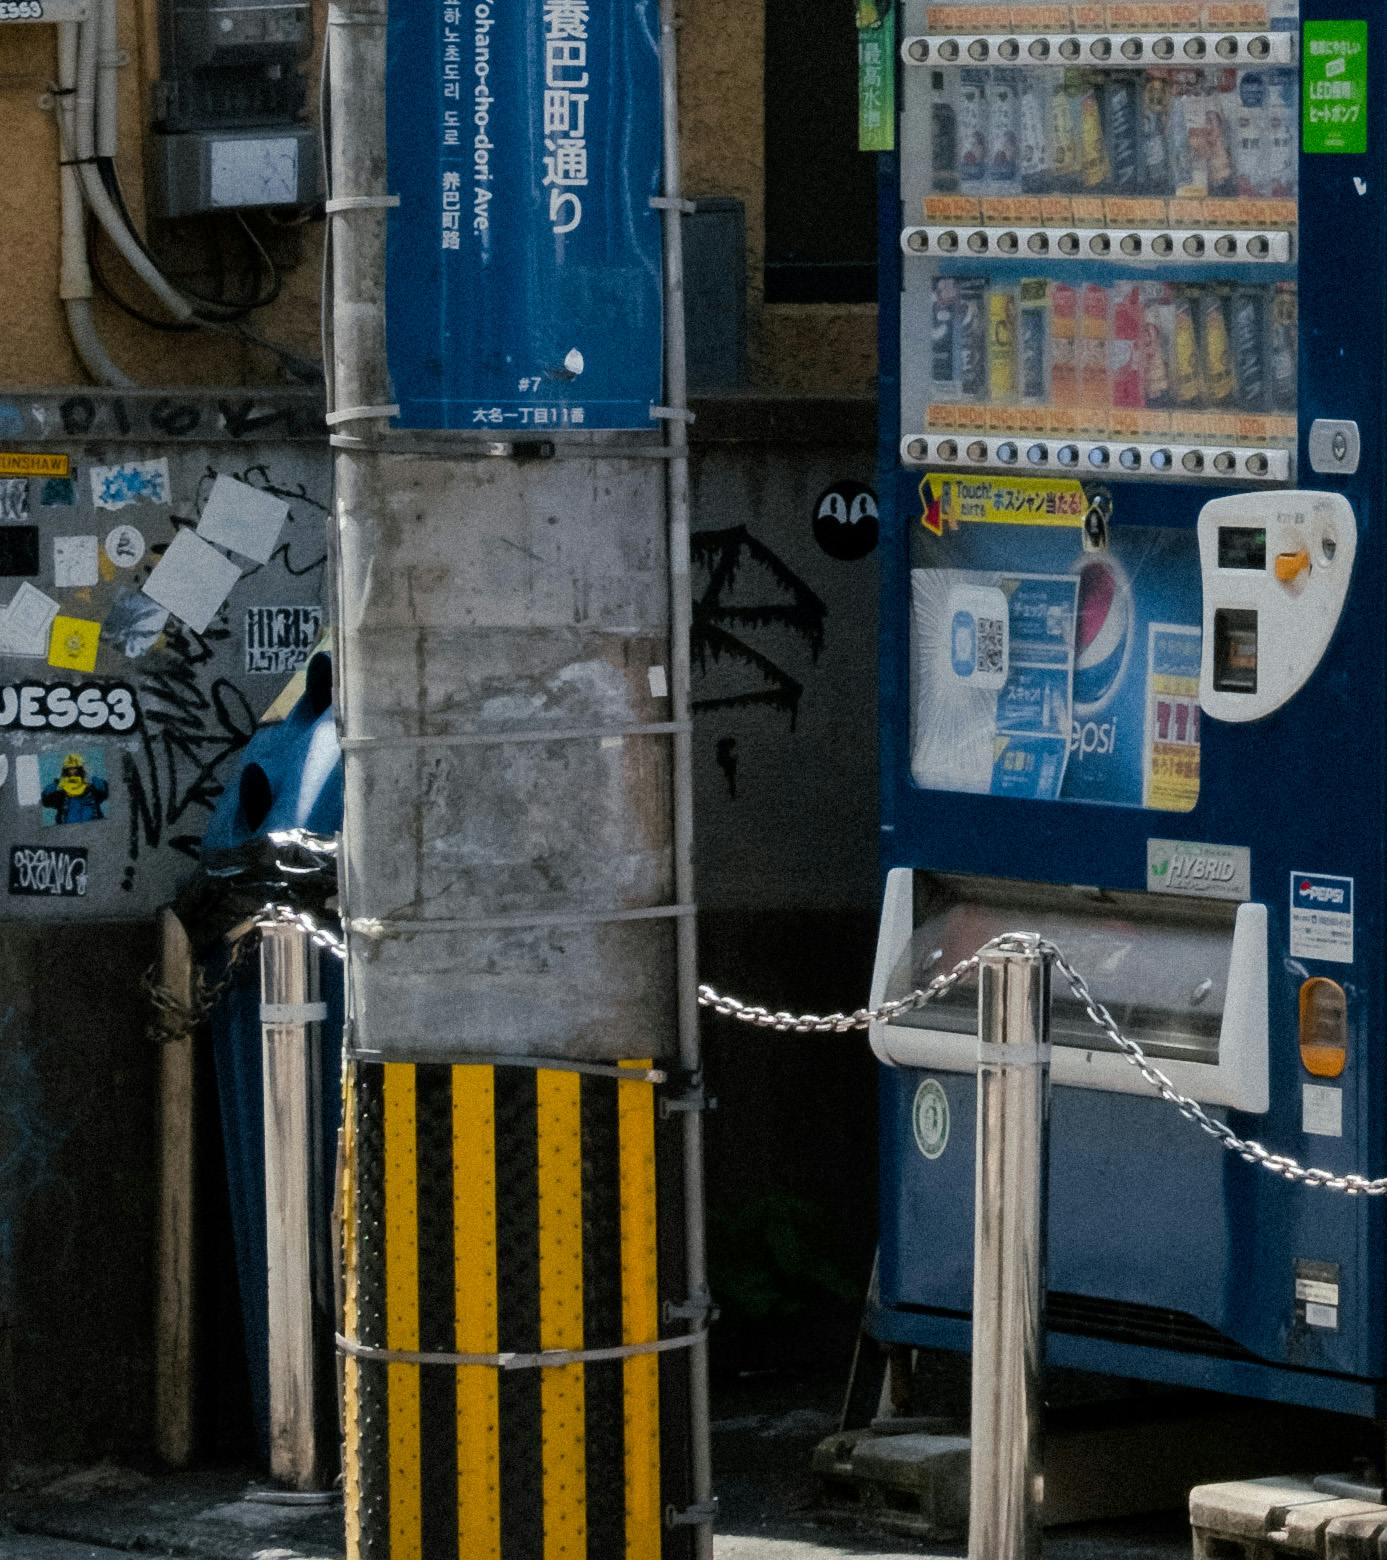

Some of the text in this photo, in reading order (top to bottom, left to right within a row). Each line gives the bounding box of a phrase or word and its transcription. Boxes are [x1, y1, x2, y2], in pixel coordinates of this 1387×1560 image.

[474, 187, 493, 236] Ave.
[518, 377, 541, 393] #7
[473, 407, 584, 424] 大名一丁目11番
[1068, 717, 1117, 760] epsi
[1169, 855, 1236, 882] HYBRID
